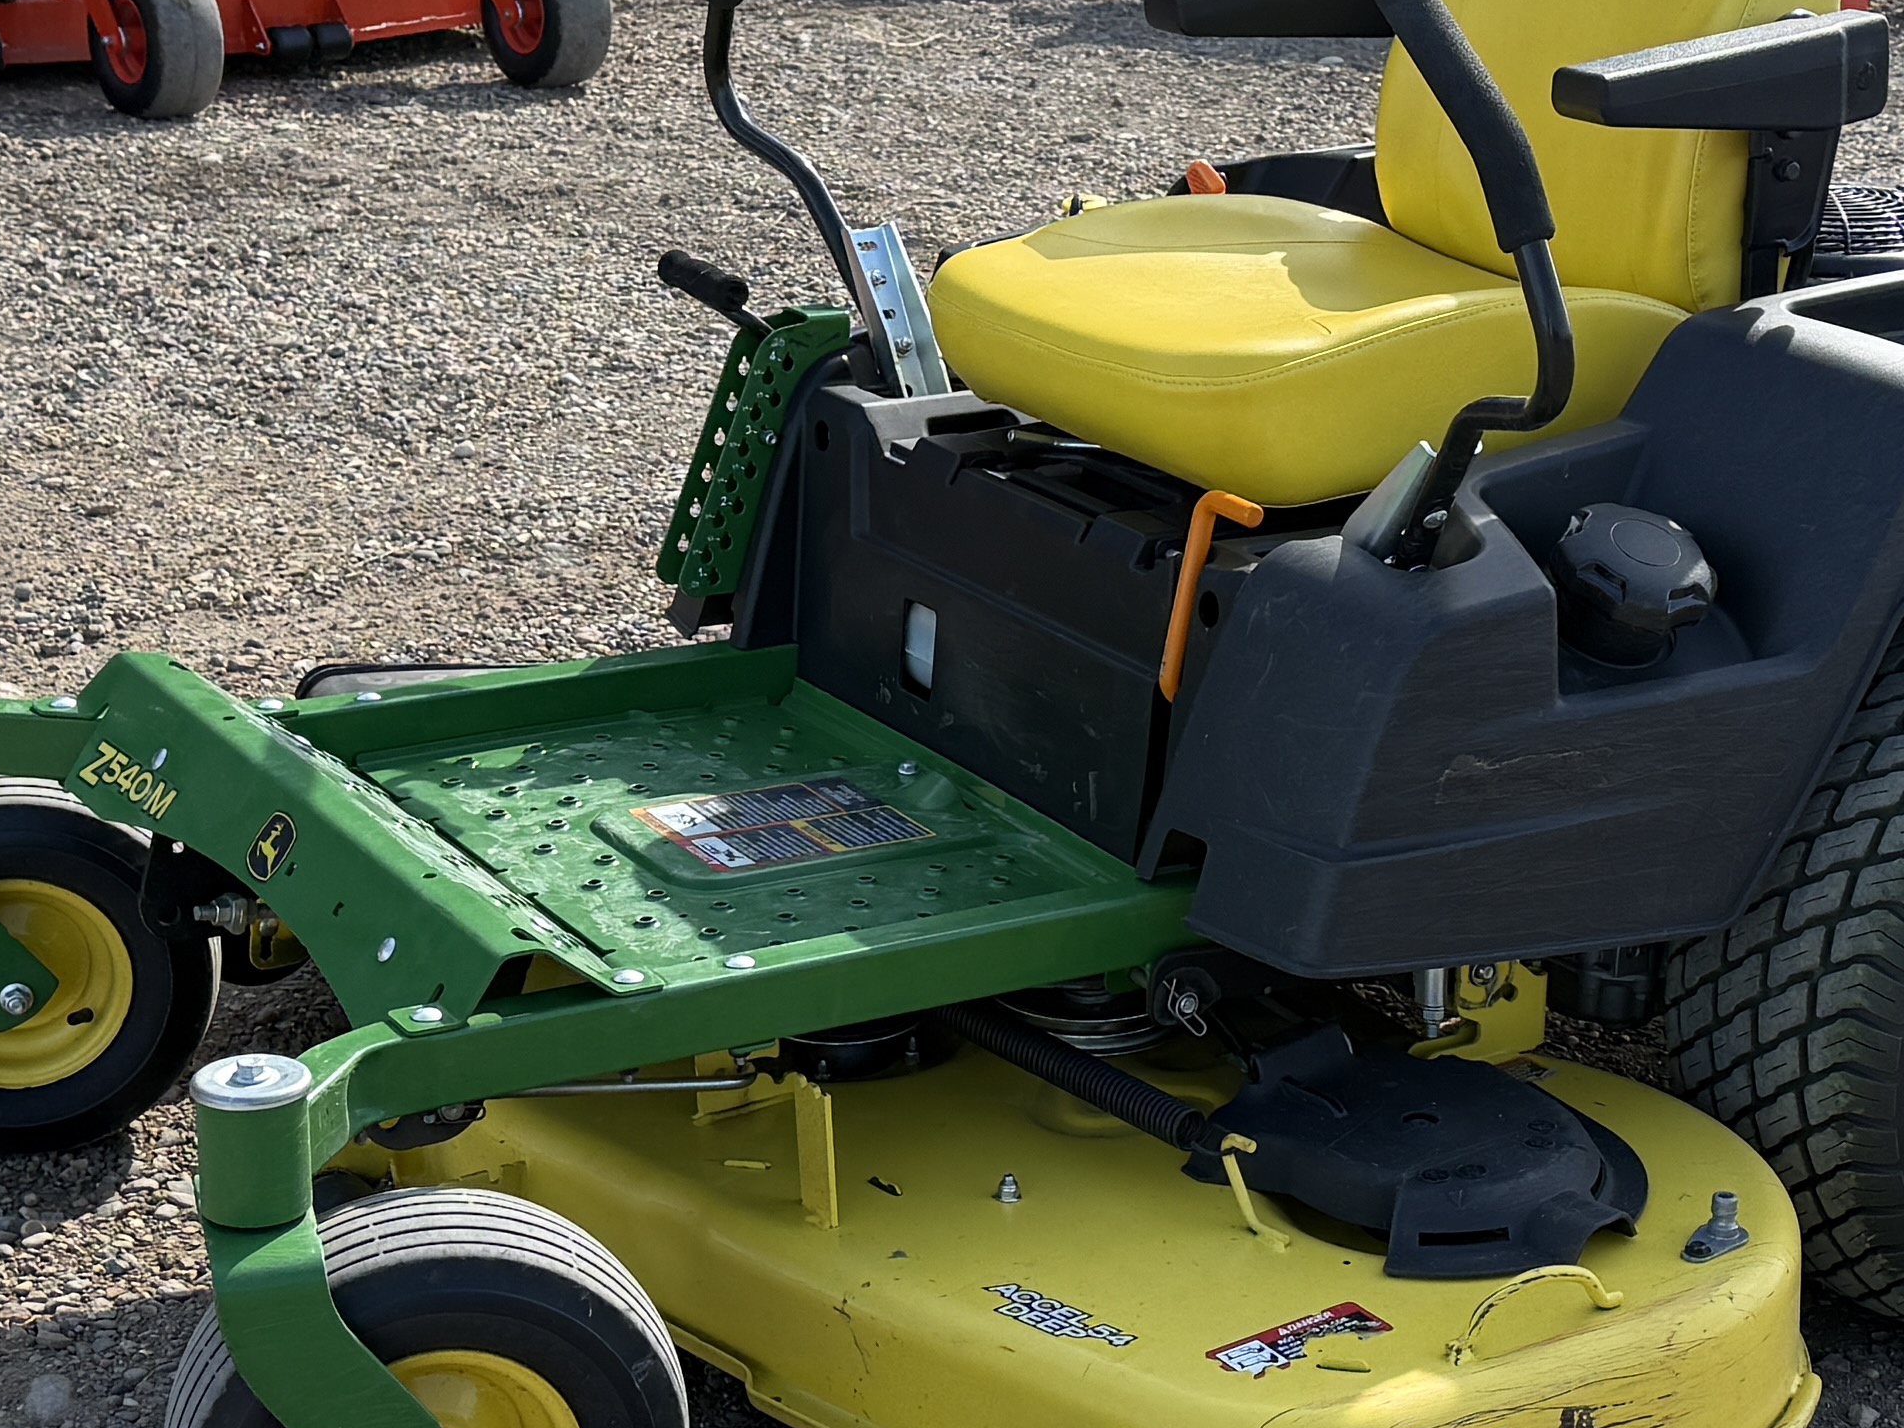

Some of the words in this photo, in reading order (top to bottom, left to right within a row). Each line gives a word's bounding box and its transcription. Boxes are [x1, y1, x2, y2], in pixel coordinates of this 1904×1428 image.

[79, 741, 178, 820] Z540M
[984, 1283, 1092, 1328] ACCEL
[1087, 1324, 1137, 1347] 54
[995, 1302, 1089, 1338] DEEP
